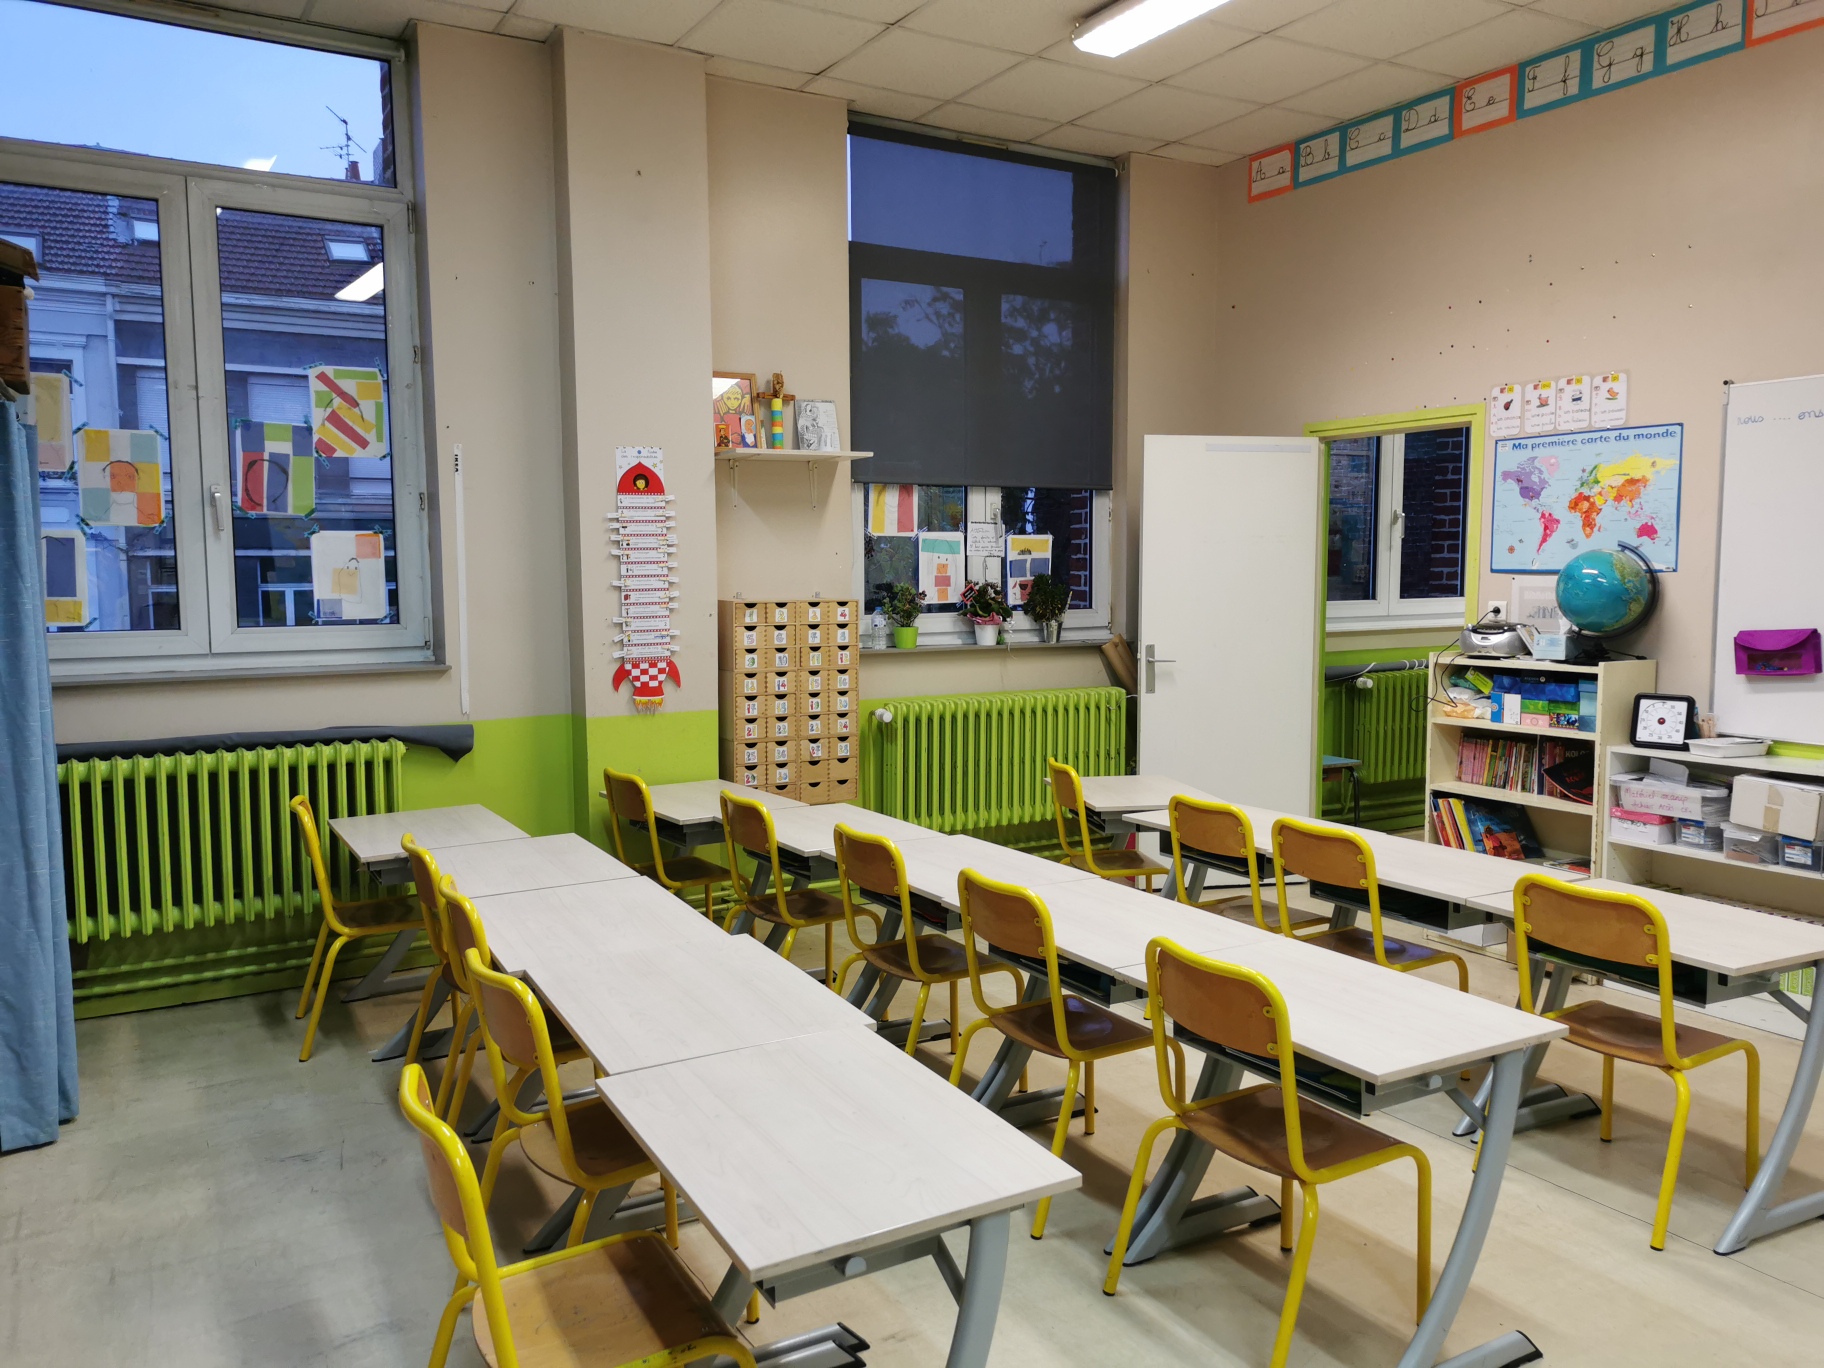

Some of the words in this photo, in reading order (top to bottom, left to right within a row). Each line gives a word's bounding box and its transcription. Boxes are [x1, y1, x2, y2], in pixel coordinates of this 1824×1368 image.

[1668, 14, 1690, 47] H
[1710, 3, 1728, 34] h
[1596, 41, 1615, 83] G
[1632, 46, 1645, 73] g
[1527, 65, 1539, 92] F
[1559, 55, 1571, 96] f
[1463, 87, 1476, 112] E
[1485, 95, 1497, 106] e
[1402, 107, 1419, 134] D
[1428, 107, 1440, 124] d
[1348, 127, 1360, 151] C
[1300, 145, 1315, 167] B
[1321, 139, 1331, 161] b
[1253, 160, 1266, 182] A
[1277, 166, 1287, 176] a
[1512, 442, 1528, 451] Ma
[1531, 438, 1578, 452] première
[1580, 435, 1610, 445] carte
[1614, 432, 1630, 442] du
[1633, 429, 1677, 440] monde
[778, 610, 785, 621] 2
[840, 610, 848, 620] 4
[746, 634, 755, 644] 5
[811, 654, 820, 664] 11
[840, 653, 848, 663] 12
[746, 680, 756, 692] 13
[776, 679, 786, 690] 14
[810, 678, 820, 689] 15
[839, 676, 848, 686] 16
[746, 703, 756, 714] 17
[810, 700, 820, 710] 19
[838, 699, 848, 708] 20
[746, 726, 756, 736] 21
[776, 724, 787, 735] 22
[810, 723, 820, 732] 23
[838, 721, 848, 730] 24
[811, 745, 820, 755] 27
[746, 751, 756, 762] 25
